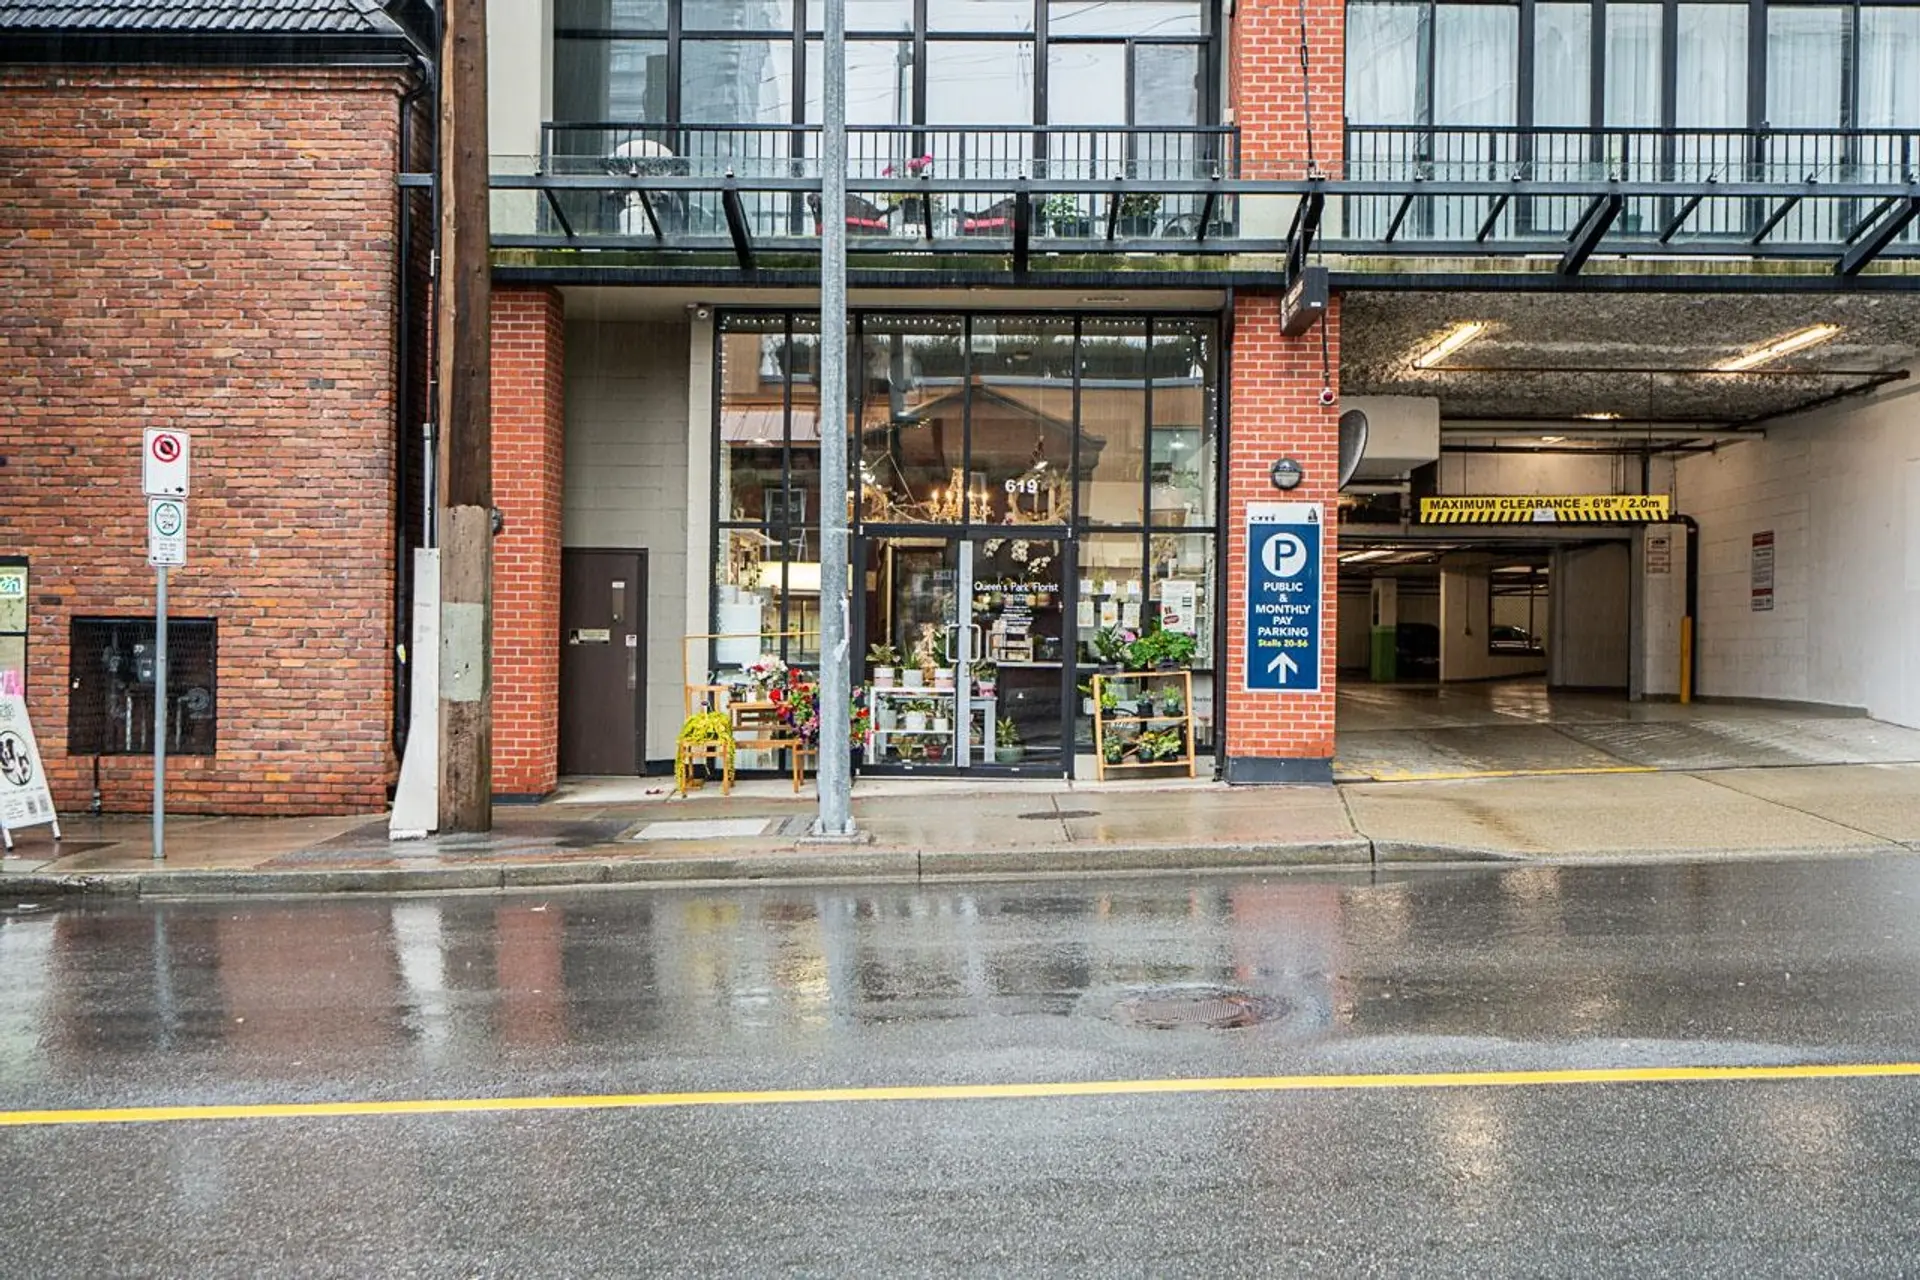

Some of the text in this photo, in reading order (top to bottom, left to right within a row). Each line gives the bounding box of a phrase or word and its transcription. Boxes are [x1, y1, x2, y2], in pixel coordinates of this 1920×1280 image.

[1005, 479, 1038, 493] 619
[1429, 499, 1497, 510] MAXIMUM
[1500, 498, 1581, 510] CLEARANCE
[1628, 498, 1660, 509] 2.0m
[1275, 540, 1297, 571] P
[973, 580, 1059, 592] Queen's Park Florist
[1263, 582, 1304, 593] PUBLIC
[1279, 593, 1289, 603] &
[1255, 604, 1311, 615] MONTHLY
[1273, 616, 1293, 625] PAY
[1257, 627, 1309, 637] PARKING
[1258, 639, 1282, 648] Stalls
